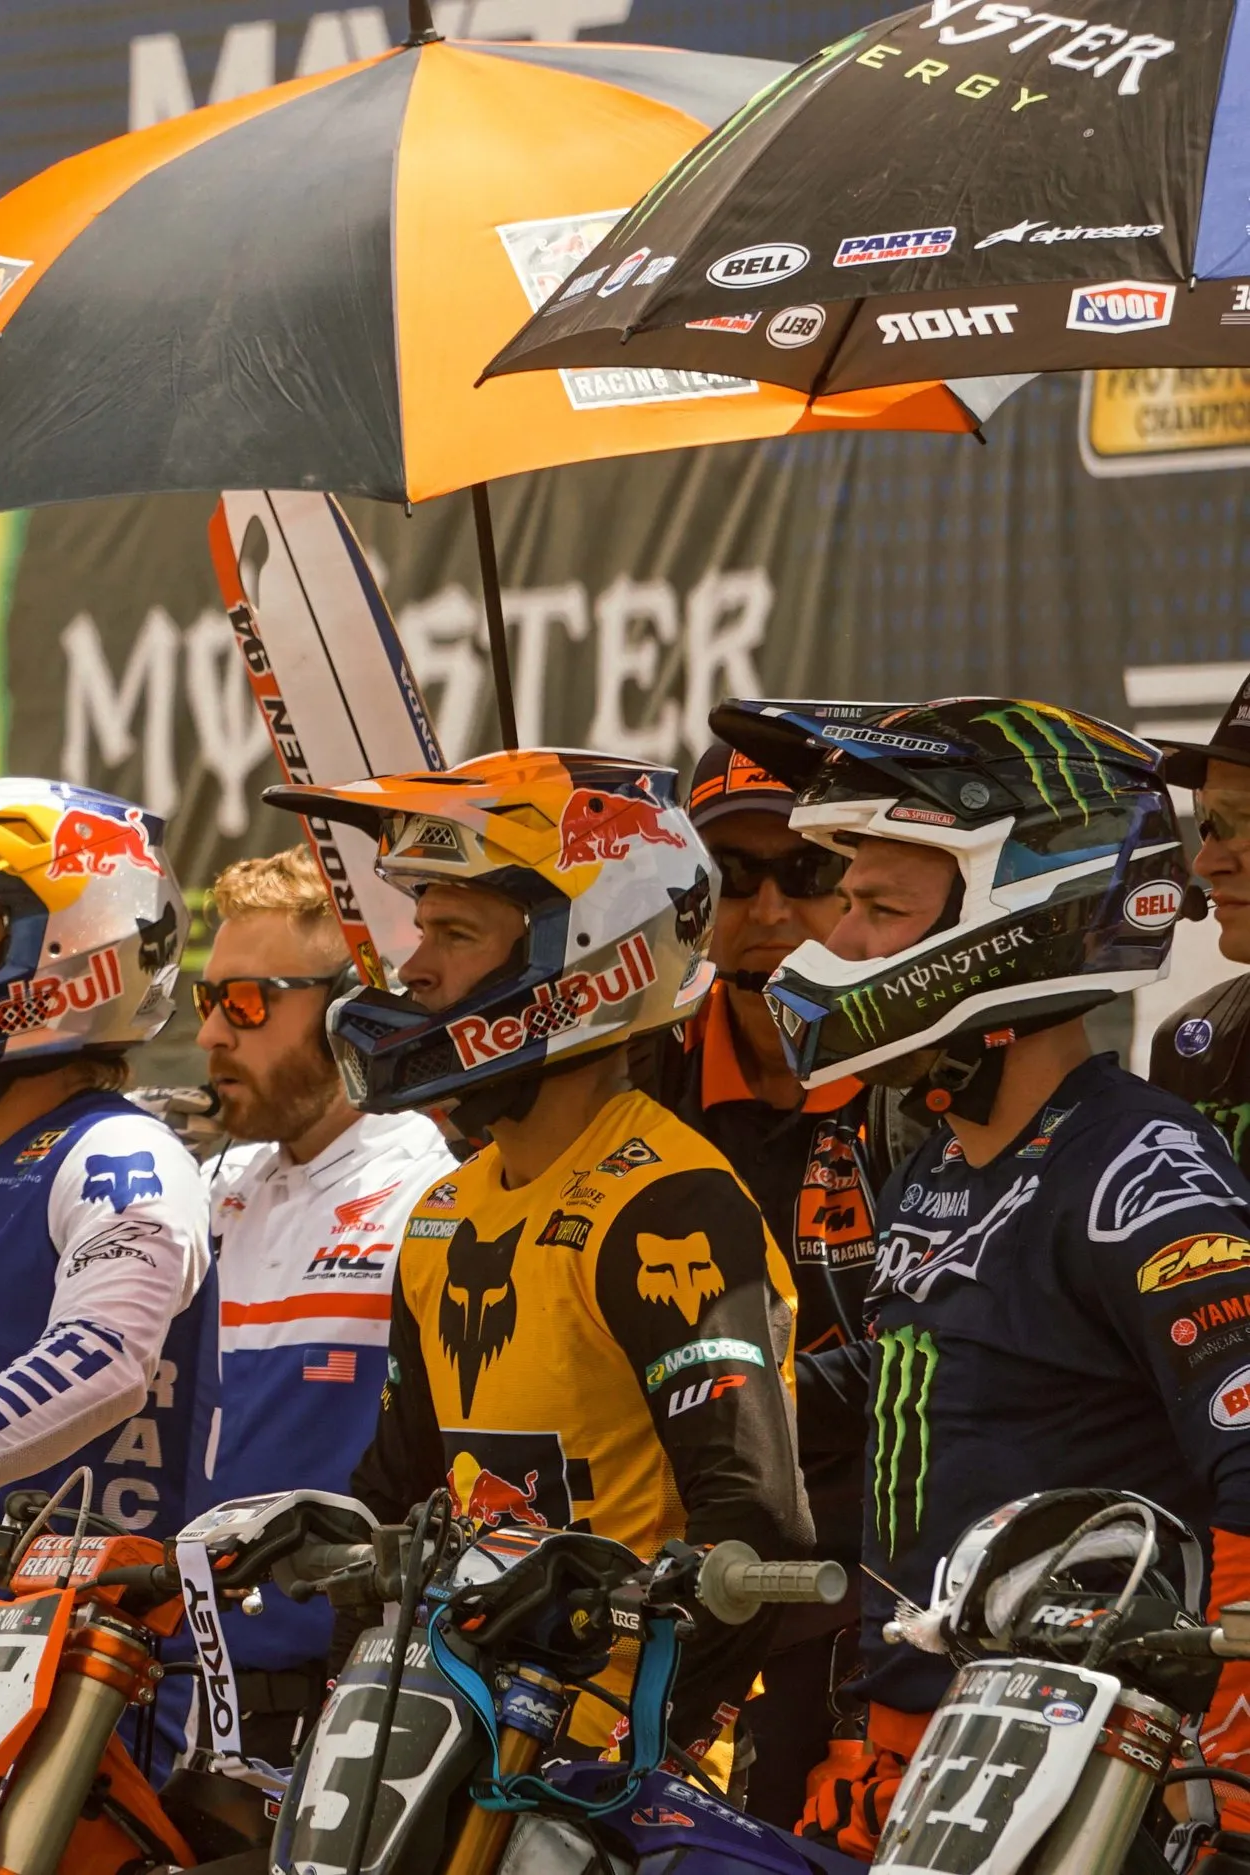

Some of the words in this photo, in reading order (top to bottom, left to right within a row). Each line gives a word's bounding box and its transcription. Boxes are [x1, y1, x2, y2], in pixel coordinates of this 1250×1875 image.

[840, 228, 953, 254] PARTS
[1028, 223, 1164, 245] alpinestars
[721, 254, 792, 277] BELL
[837, 244, 948, 265] UNLIMITED
[574, 369, 669, 398] RACING
[58, 560, 774, 838] MOSTER
[827, 707, 862, 718] TOMAC
[399, 660, 447, 772] ONDA
[822, 724, 948, 754] apdesigns
[910, 810, 952, 824] SPHERICAL
[1135, 893, 1176, 917] BELL
[882, 926, 1034, 999] MONSTER
[30, 948, 125, 1021] Bull
[916, 958, 1017, 1008] ENERGY
[445, 982, 553, 1072] Red
[555, 930, 659, 1018] Bull
[330, 1222, 386, 1235] HONDA
[306, 1243, 395, 1273] HRC
[832, 1240, 876, 1263] RACING
[664, 1339, 758, 1374] MOTOREX
[668, 1373, 748, 1418] WP
[2, 1609, 24, 1629] OIL
[184, 1578, 233, 1738] OAKLEY
[404, 1642, 431, 1668] OIL
[1005, 1671, 1039, 1699] OIL
